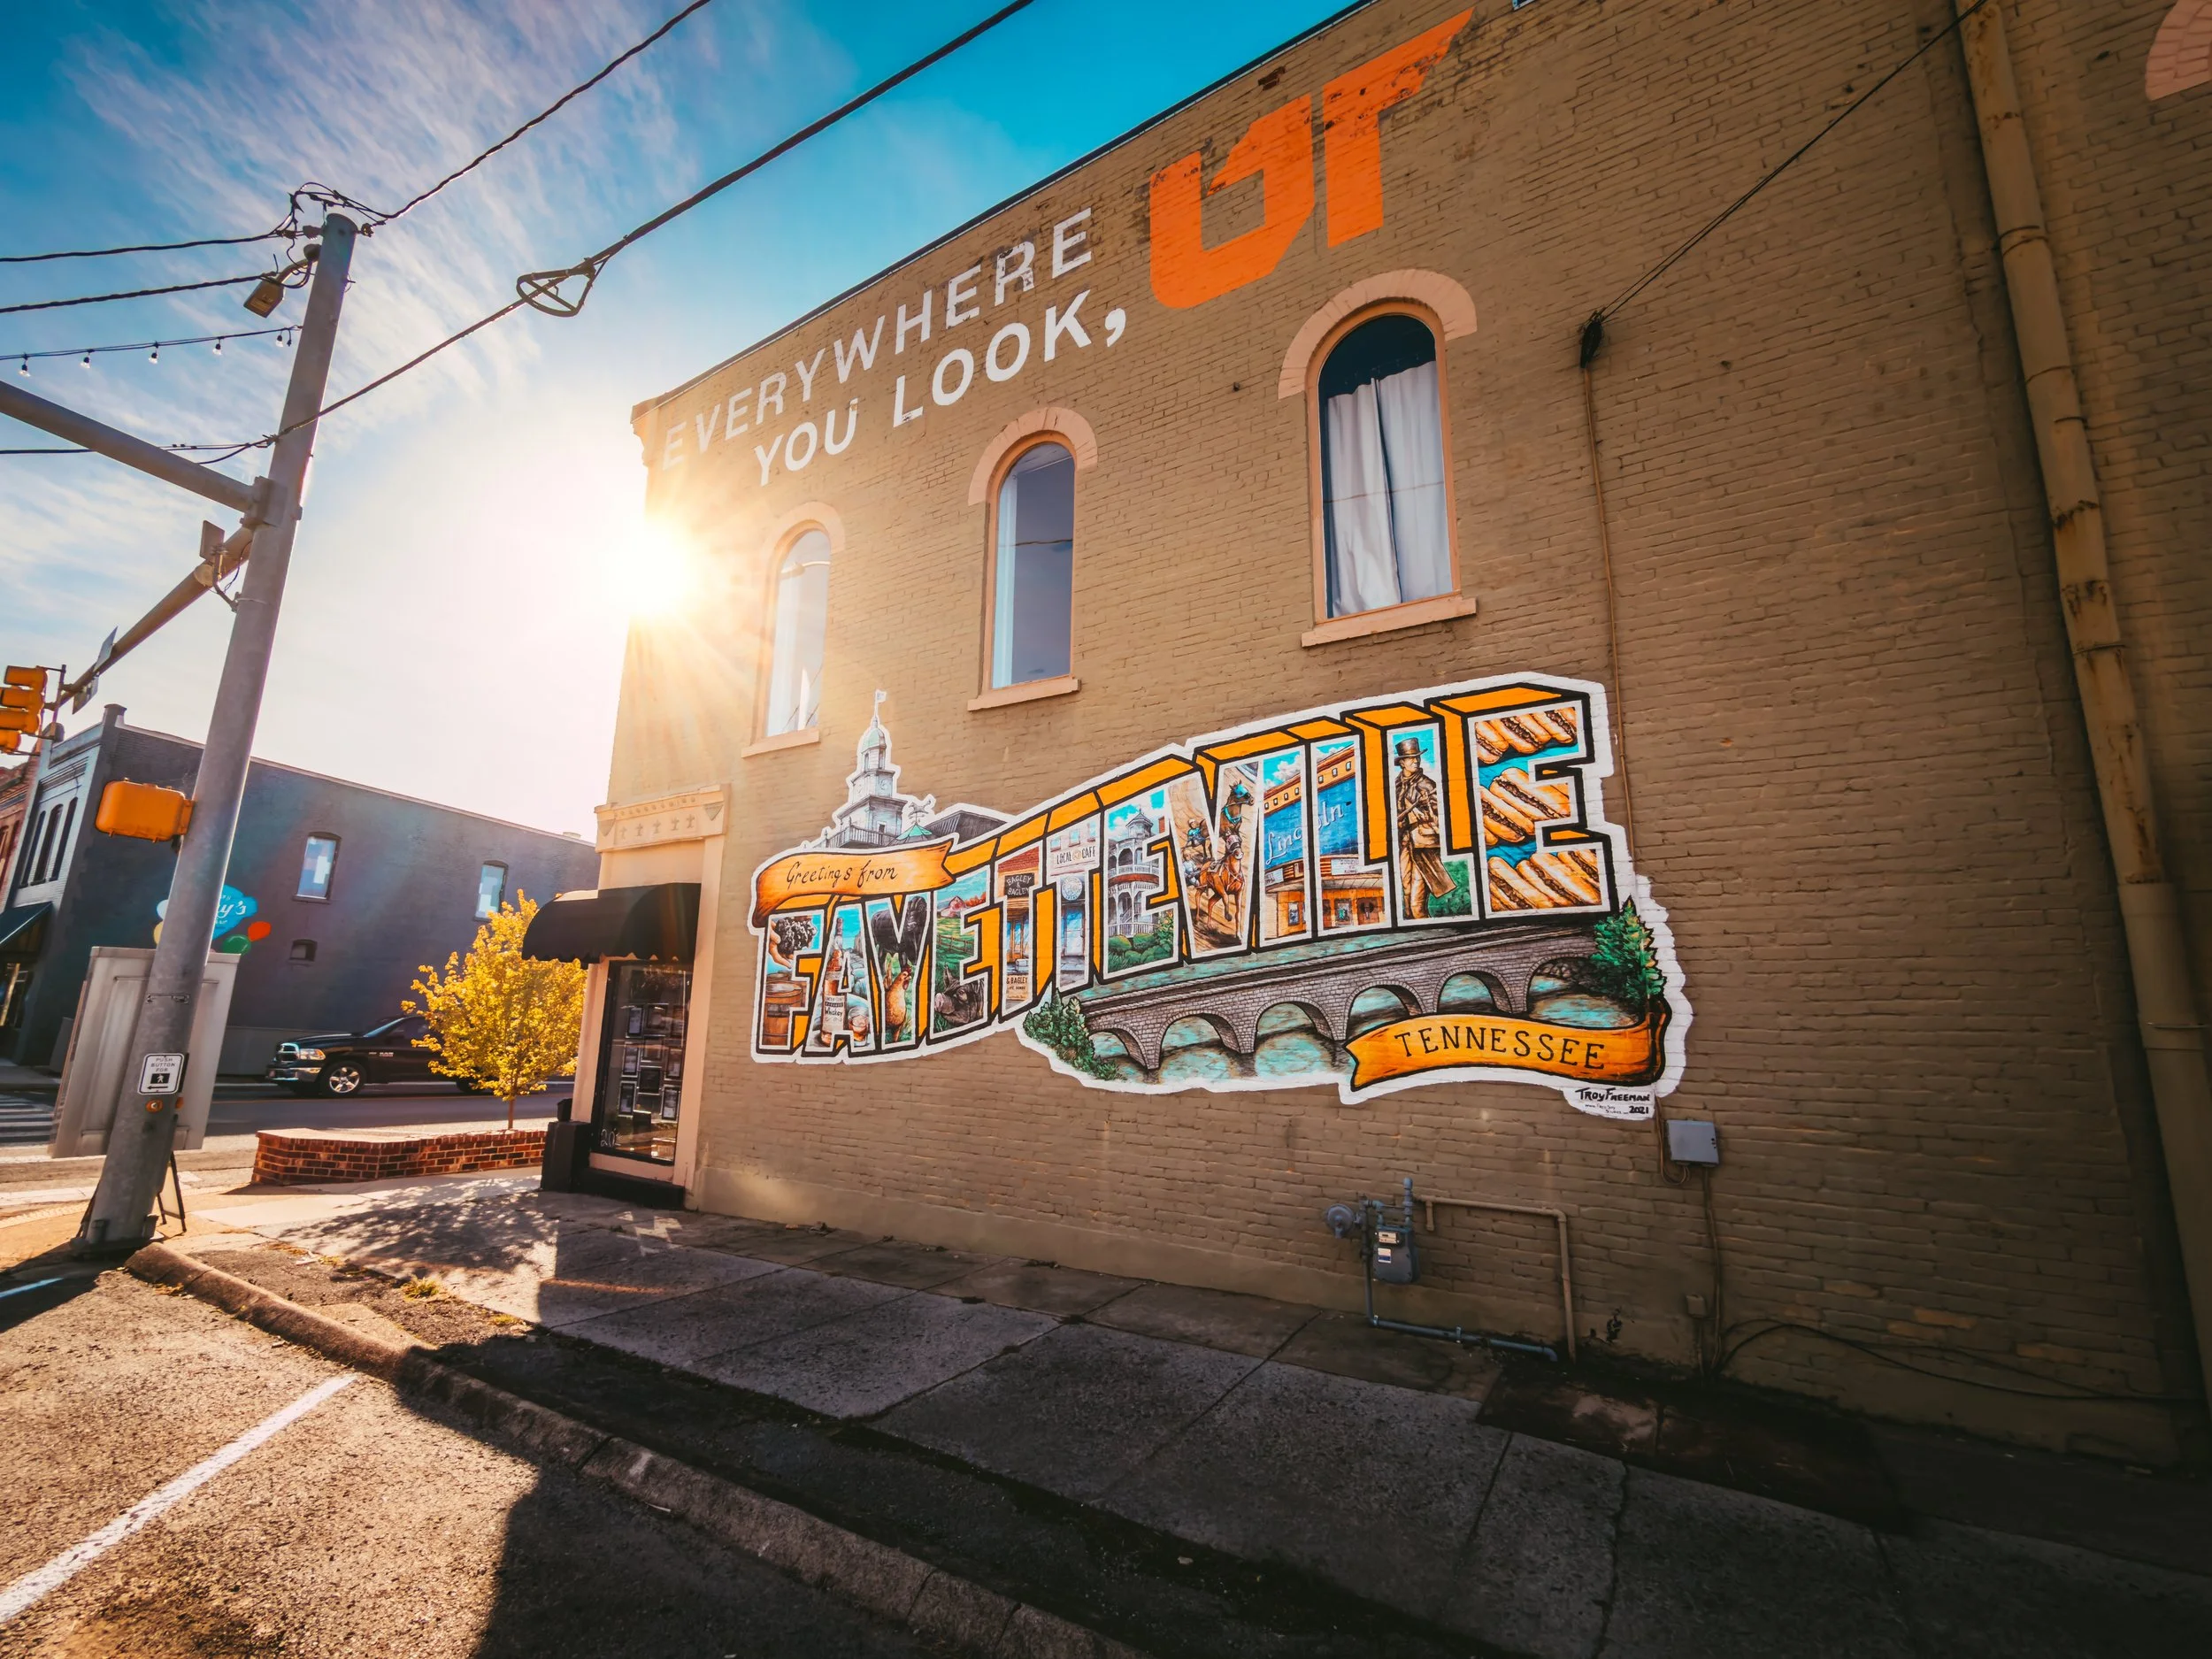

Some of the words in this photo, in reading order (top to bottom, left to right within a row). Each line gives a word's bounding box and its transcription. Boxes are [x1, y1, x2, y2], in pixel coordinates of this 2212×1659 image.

[1149, 8, 1475, 309] UT
[662, 208, 1093, 471] EVERYWHERE
[754, 397, 859, 487] YOU
[892, 289, 1127, 428] LOOK,
[757, 683, 1613, 1055] FAYETTEVILLE
[787, 861, 852, 890] Greetings
[856, 860, 898, 888] from
[1006, 875, 1033, 885] BAGLEY
[1056, 851, 1072, 864] LOCAL
[1394, 1025, 1605, 1070] TENNESSEE
[1629, 1105, 1649, 1114] 2021
